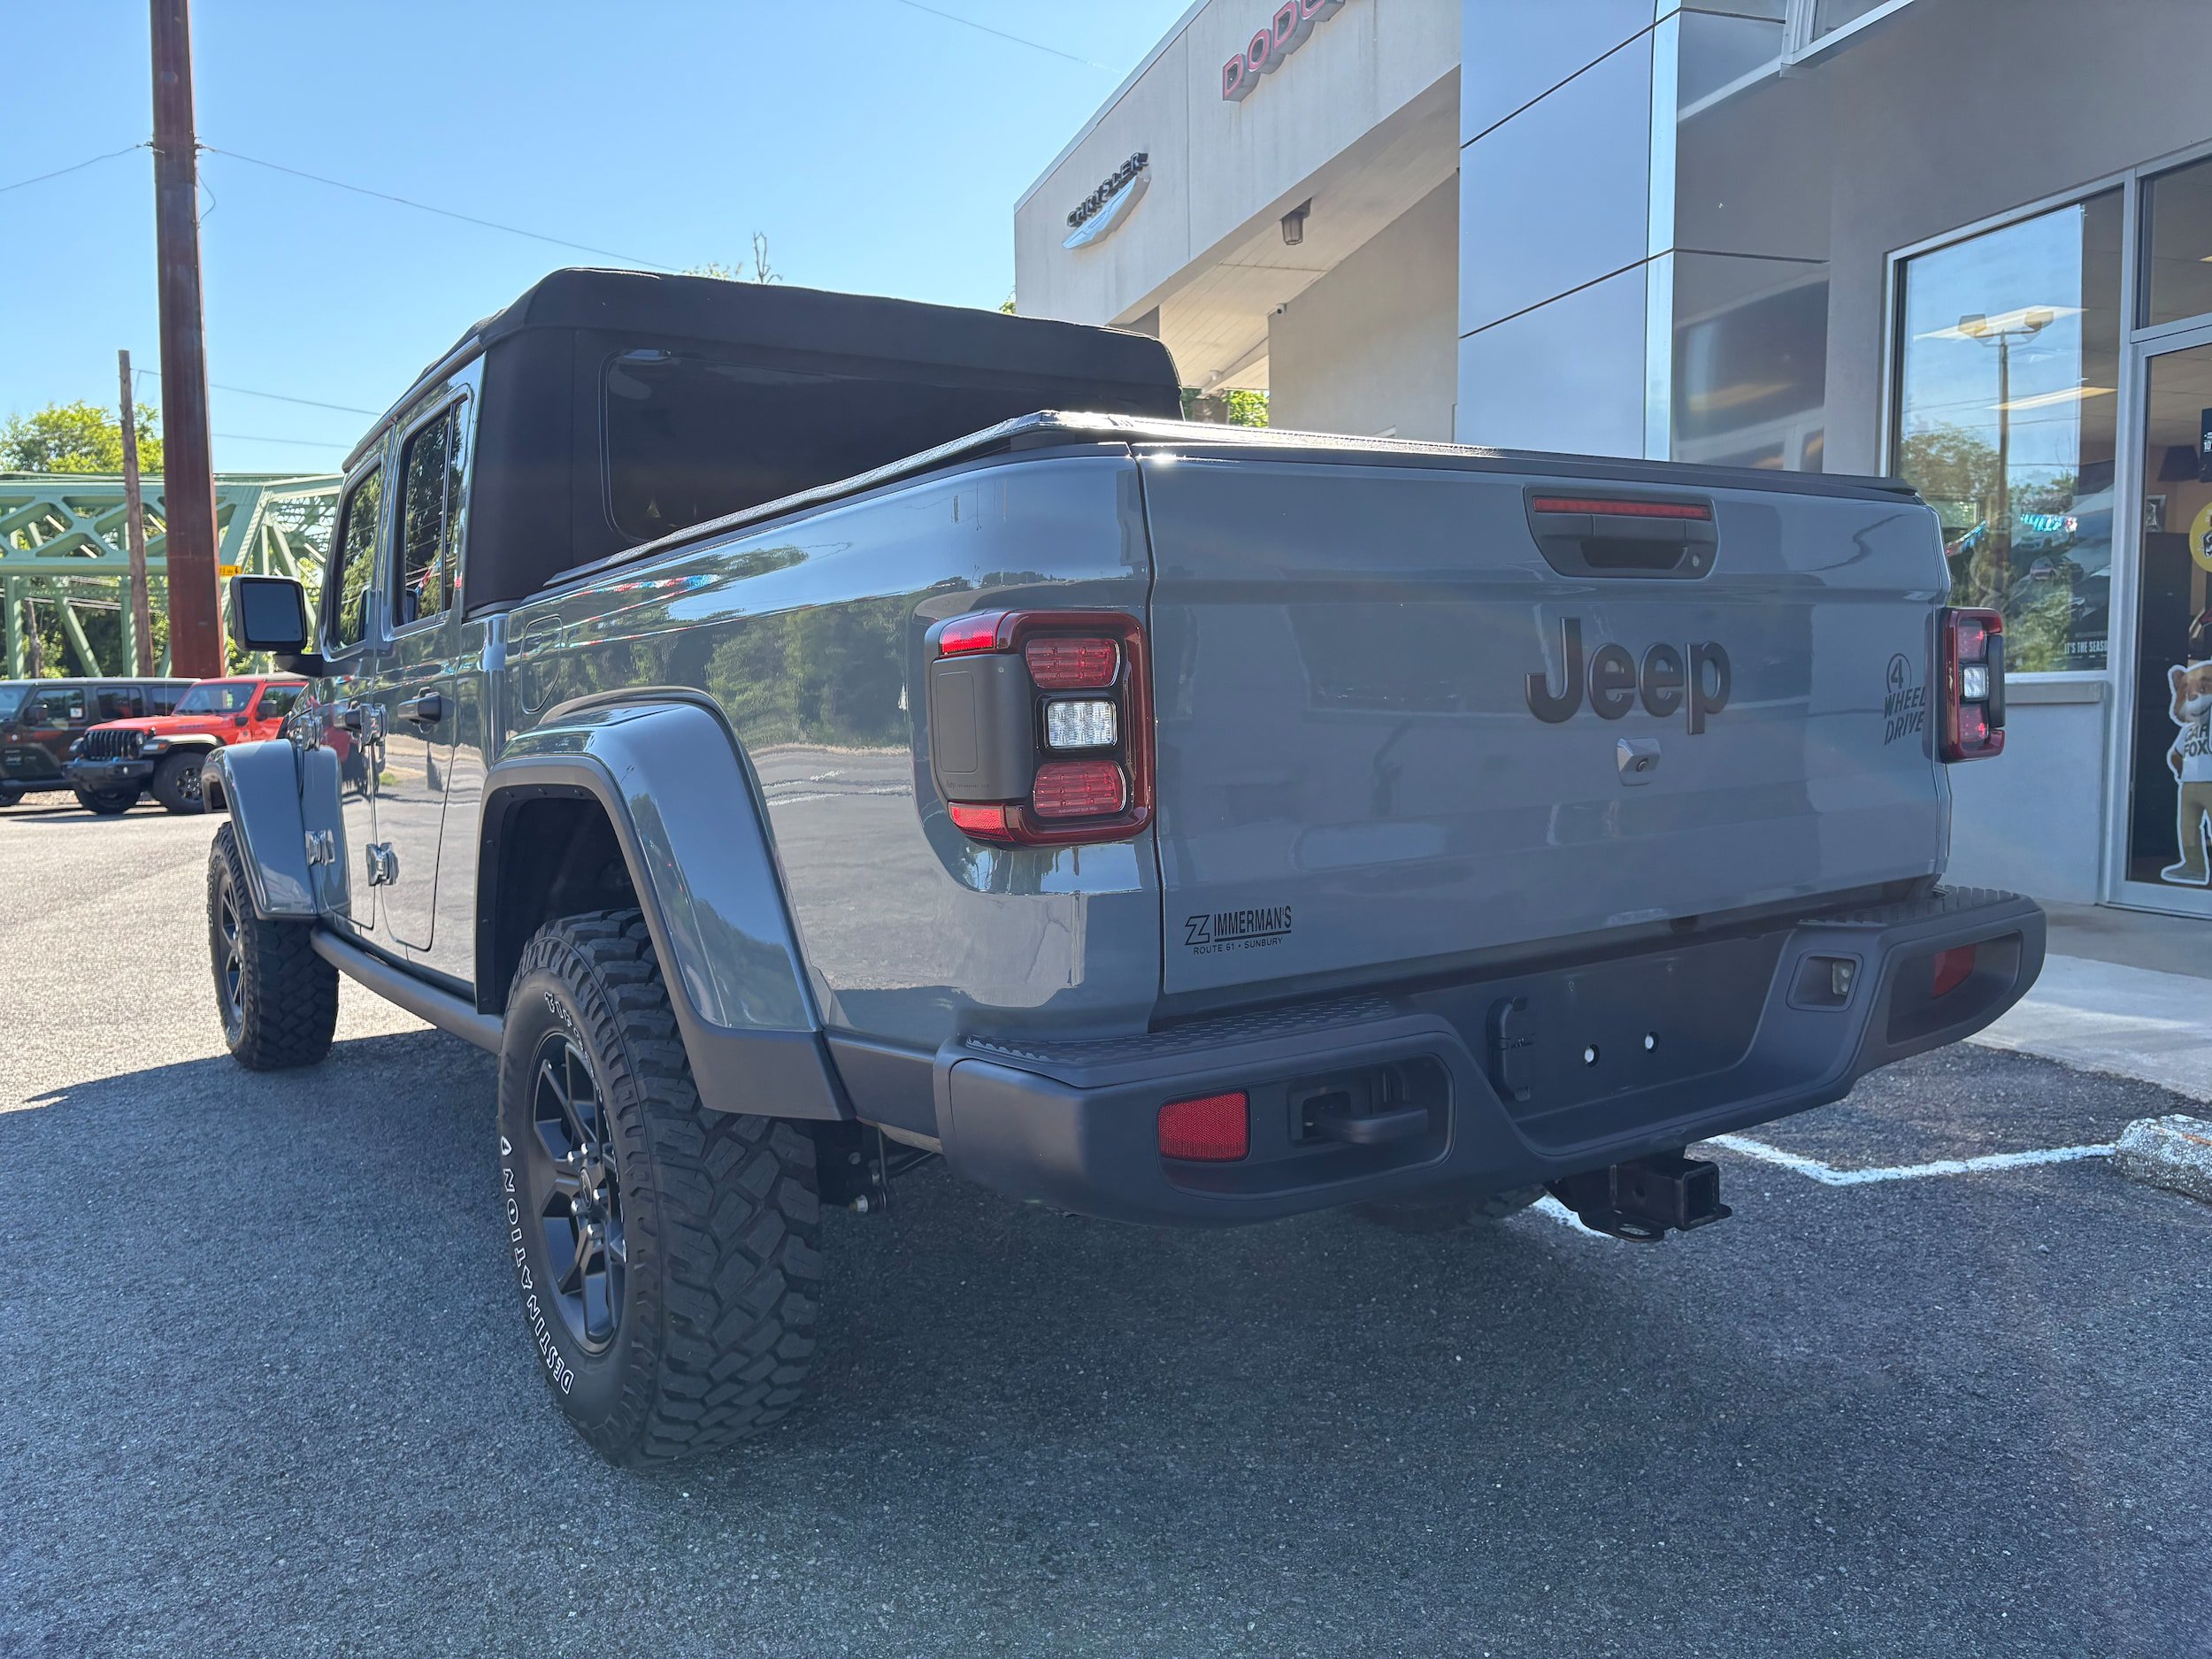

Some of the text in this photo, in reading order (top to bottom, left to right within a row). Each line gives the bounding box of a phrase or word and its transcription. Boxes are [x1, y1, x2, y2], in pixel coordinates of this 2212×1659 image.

[1067, 152, 1148, 227] CHRYSLER
[2077, 641, 2087, 653] THE
[1525, 617, 1732, 735] Jeep
[1884, 687, 1925, 719] WHEEL
[1884, 710, 1925, 746] DRIVE
[2184, 740, 2209, 757] FOX
[1193, 944, 1223, 955] ROUTE
[1244, 936, 1283, 949] SUNBURY
[503, 1168, 575, 1395] DESTINATION
